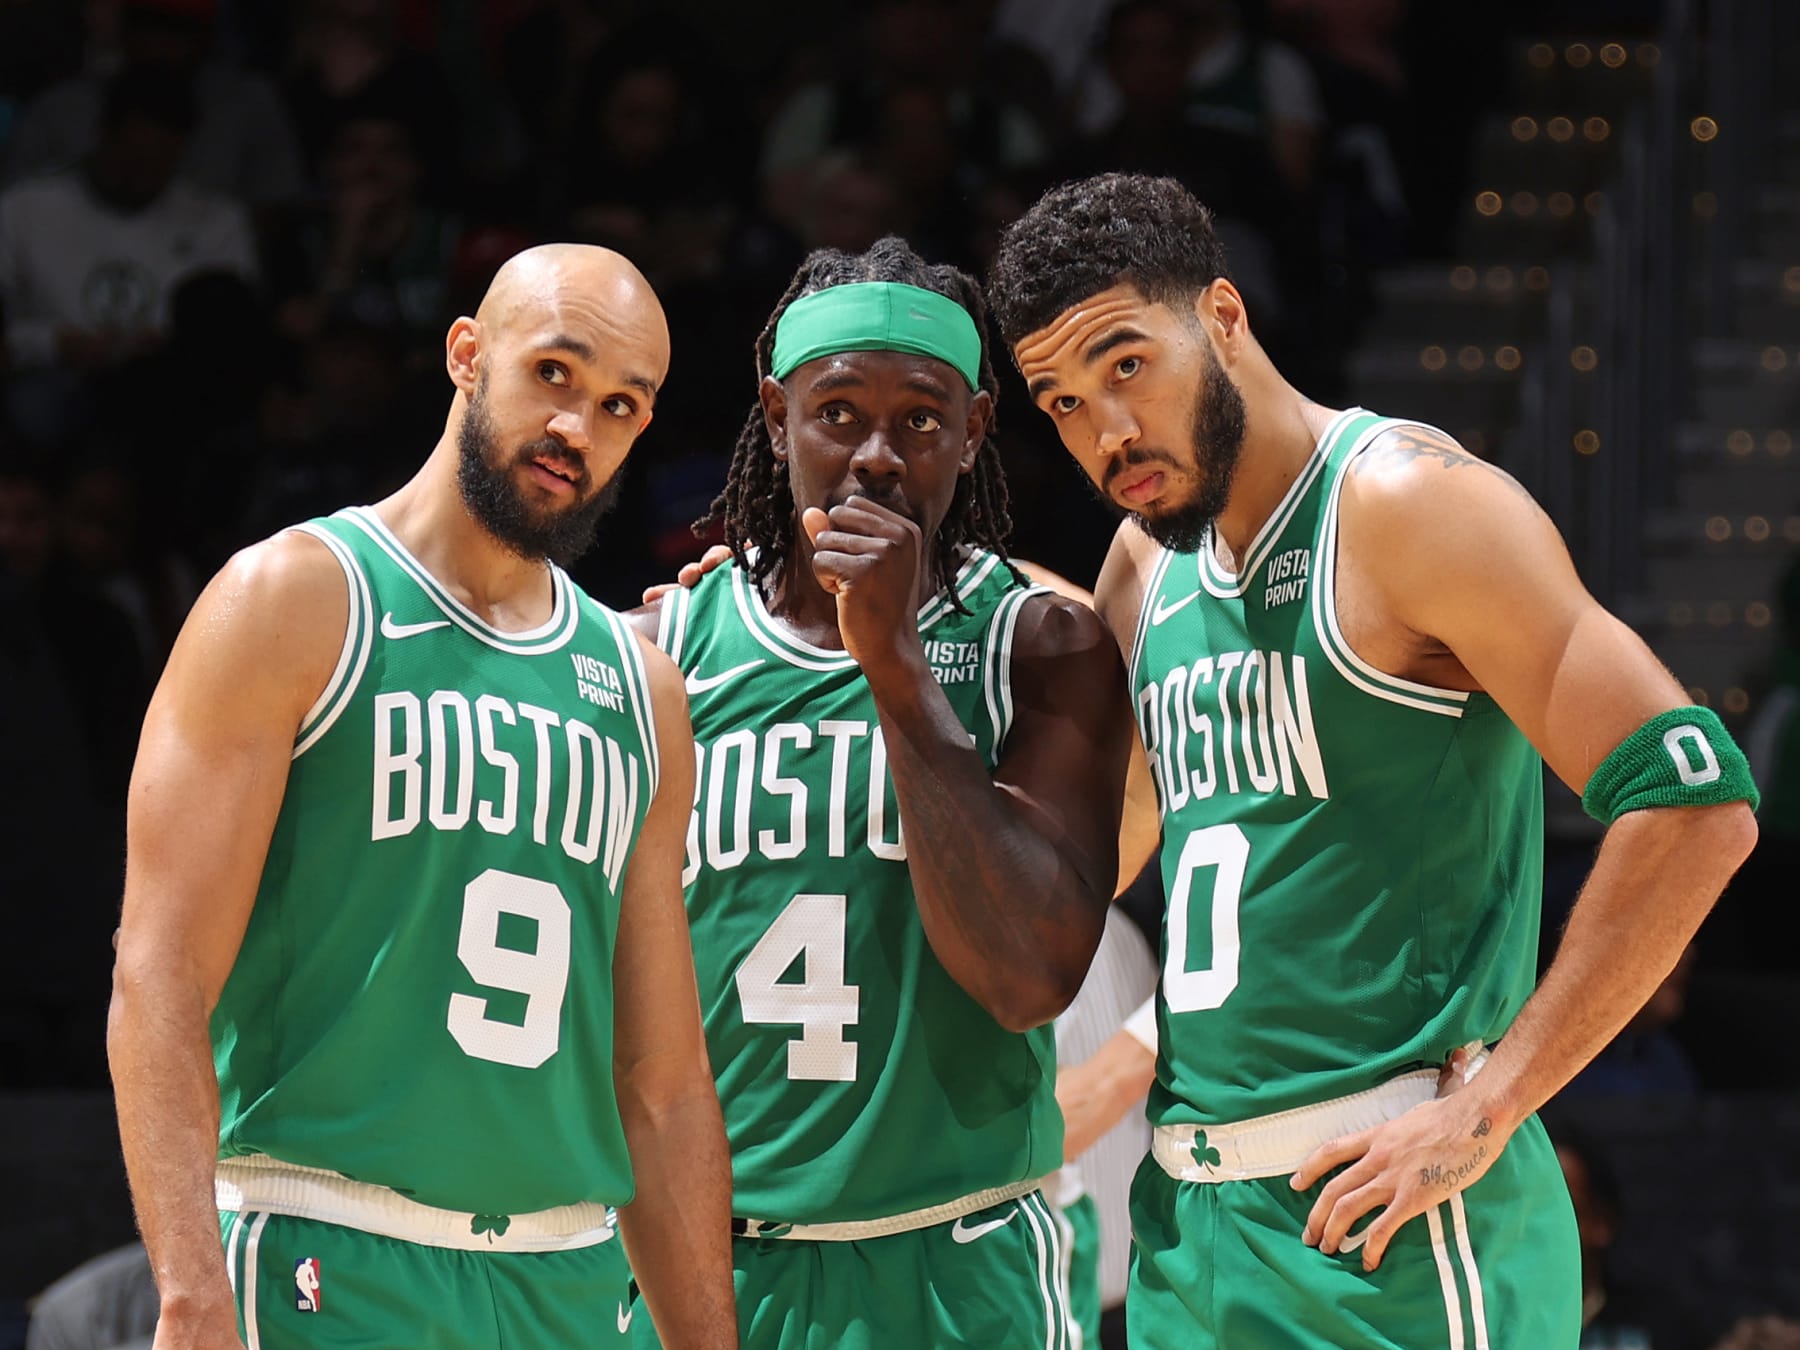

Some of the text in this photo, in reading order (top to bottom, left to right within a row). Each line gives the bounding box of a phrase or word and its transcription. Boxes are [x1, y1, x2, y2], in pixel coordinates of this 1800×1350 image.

[1264, 577, 1307, 610] PRINT
[1267, 548, 1310, 587] VISTA
[571, 653, 622, 694] VISTA
[578, 679, 625, 713] PRINT
[930, 664, 979, 690] RINT
[1138, 649, 1329, 832] BOSTON
[1663, 724, 1721, 786] 0
[372, 690, 639, 897] BOSTON
[682, 719, 910, 889] OSTO
[1163, 823, 1251, 1015] 0
[446, 868, 572, 1069] 9
[735, 894, 859, 1081] 4
[1419, 1144, 1488, 1192] Big Deuce
